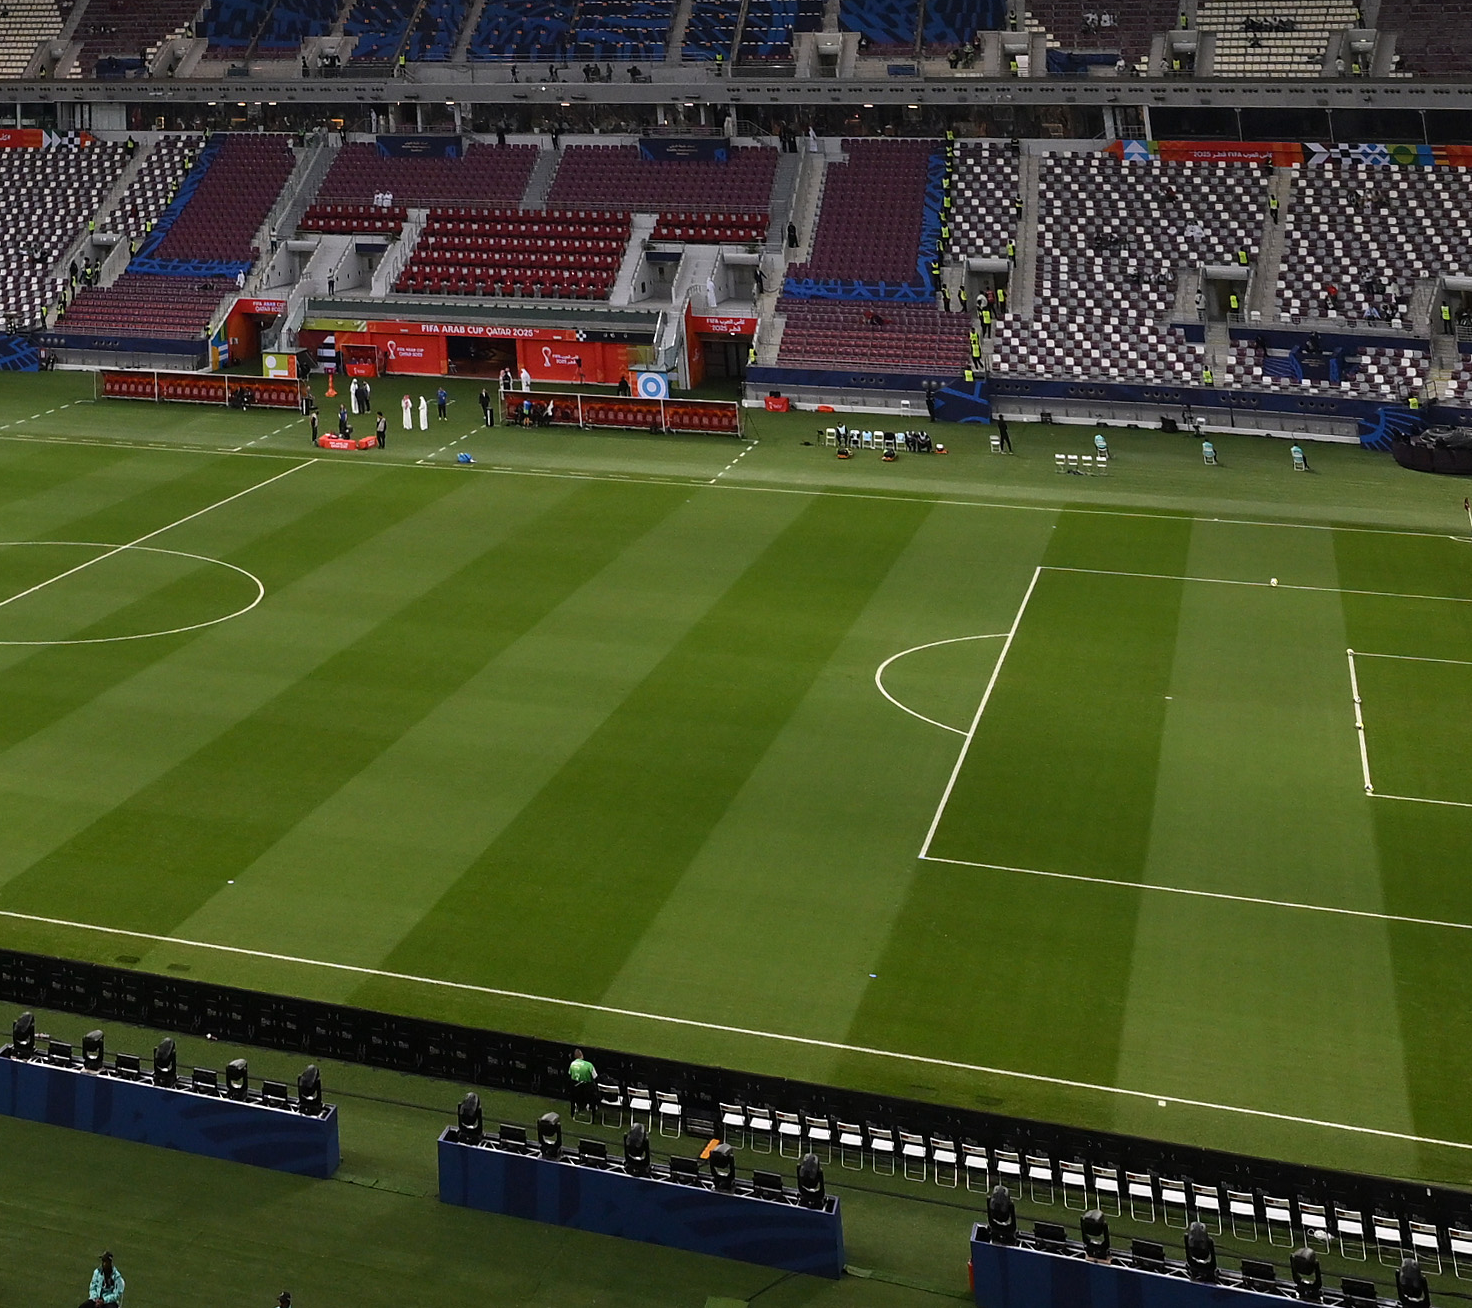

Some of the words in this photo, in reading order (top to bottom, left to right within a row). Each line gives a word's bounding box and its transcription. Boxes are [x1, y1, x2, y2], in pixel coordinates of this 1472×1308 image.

[421, 324, 440, 333] FIFA
[441, 325, 466, 334] ARAB
[467, 326, 484, 335] CUP
[486, 326, 512, 336] QATAR
